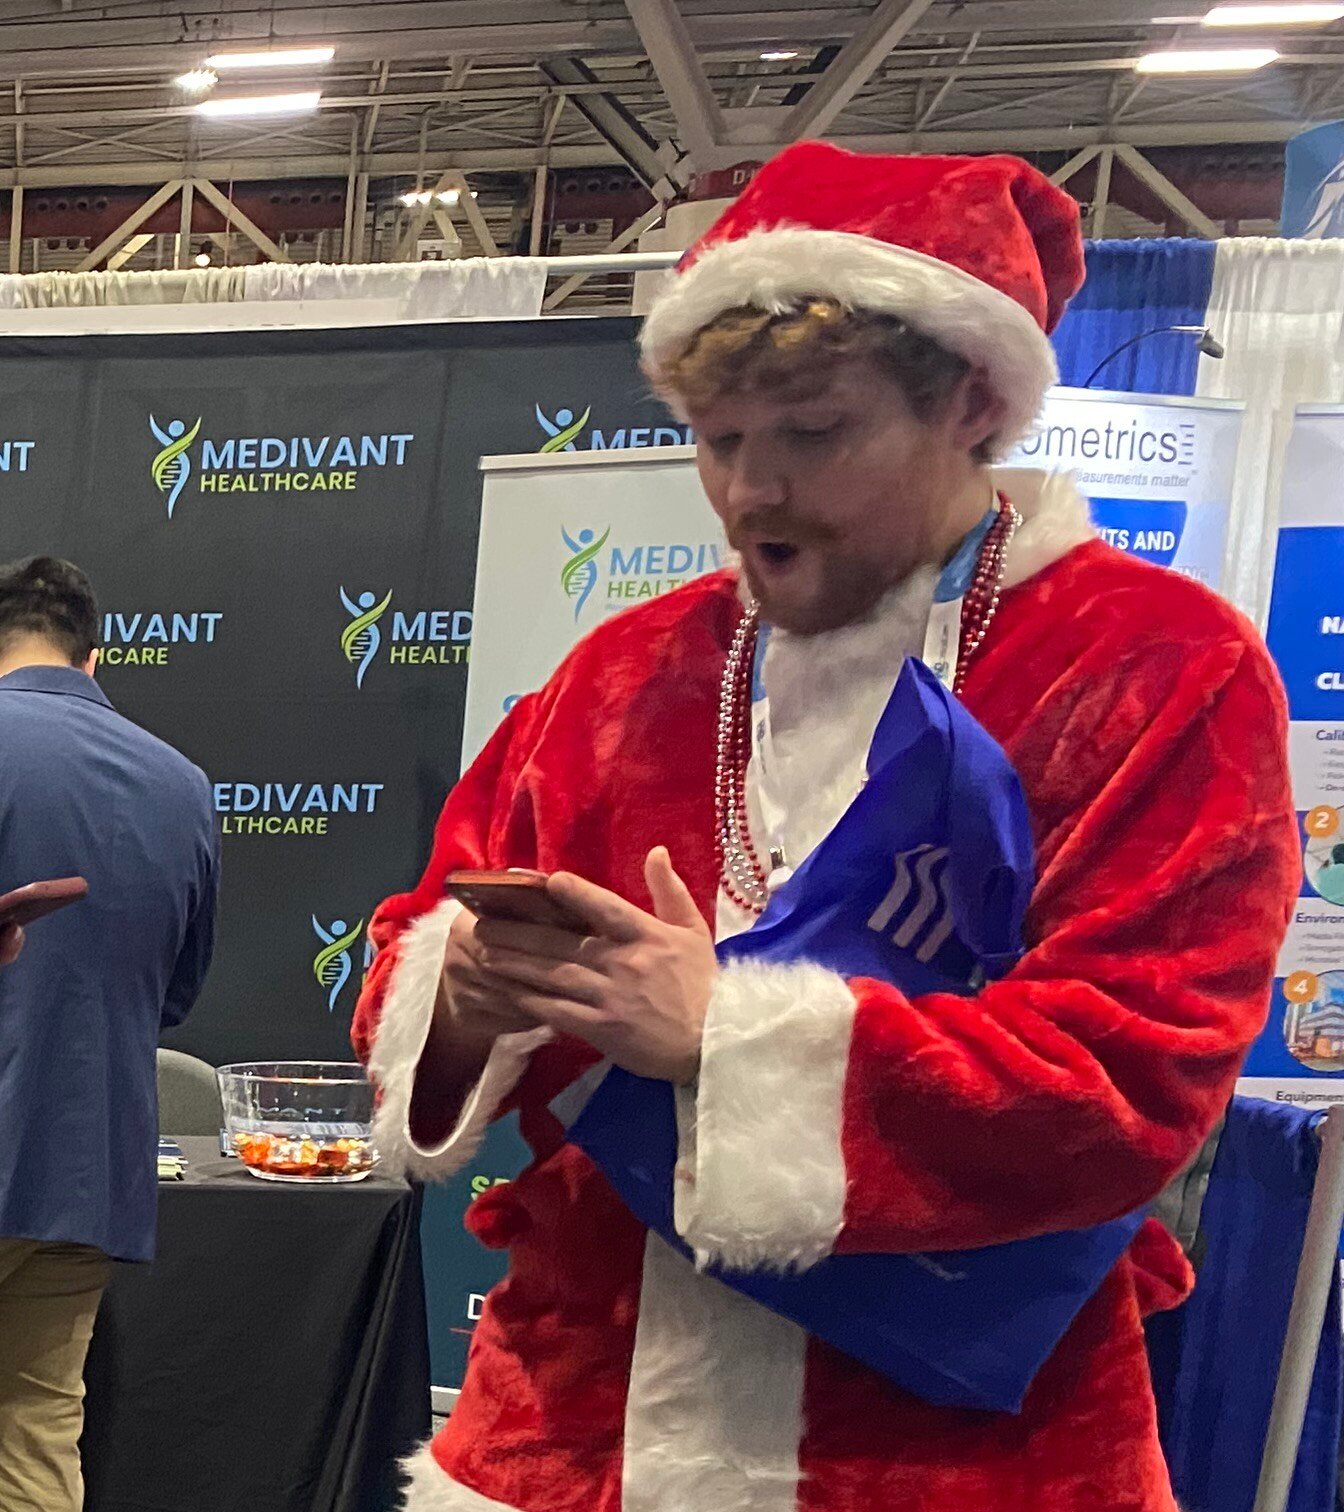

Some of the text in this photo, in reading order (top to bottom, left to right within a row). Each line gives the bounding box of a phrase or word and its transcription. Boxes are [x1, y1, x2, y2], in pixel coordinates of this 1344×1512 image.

[201, 434, 414, 470] MEDIVANT
[200, 471, 358, 492] HEALTHCARE
[1133, 531, 1176, 551] AND
[213, 783, 385, 813] EDIVANT
[222, 816, 329, 835] LTHCARE
[1315, 812, 1330, 829] 2
[1294, 978, 1309, 995] 4
